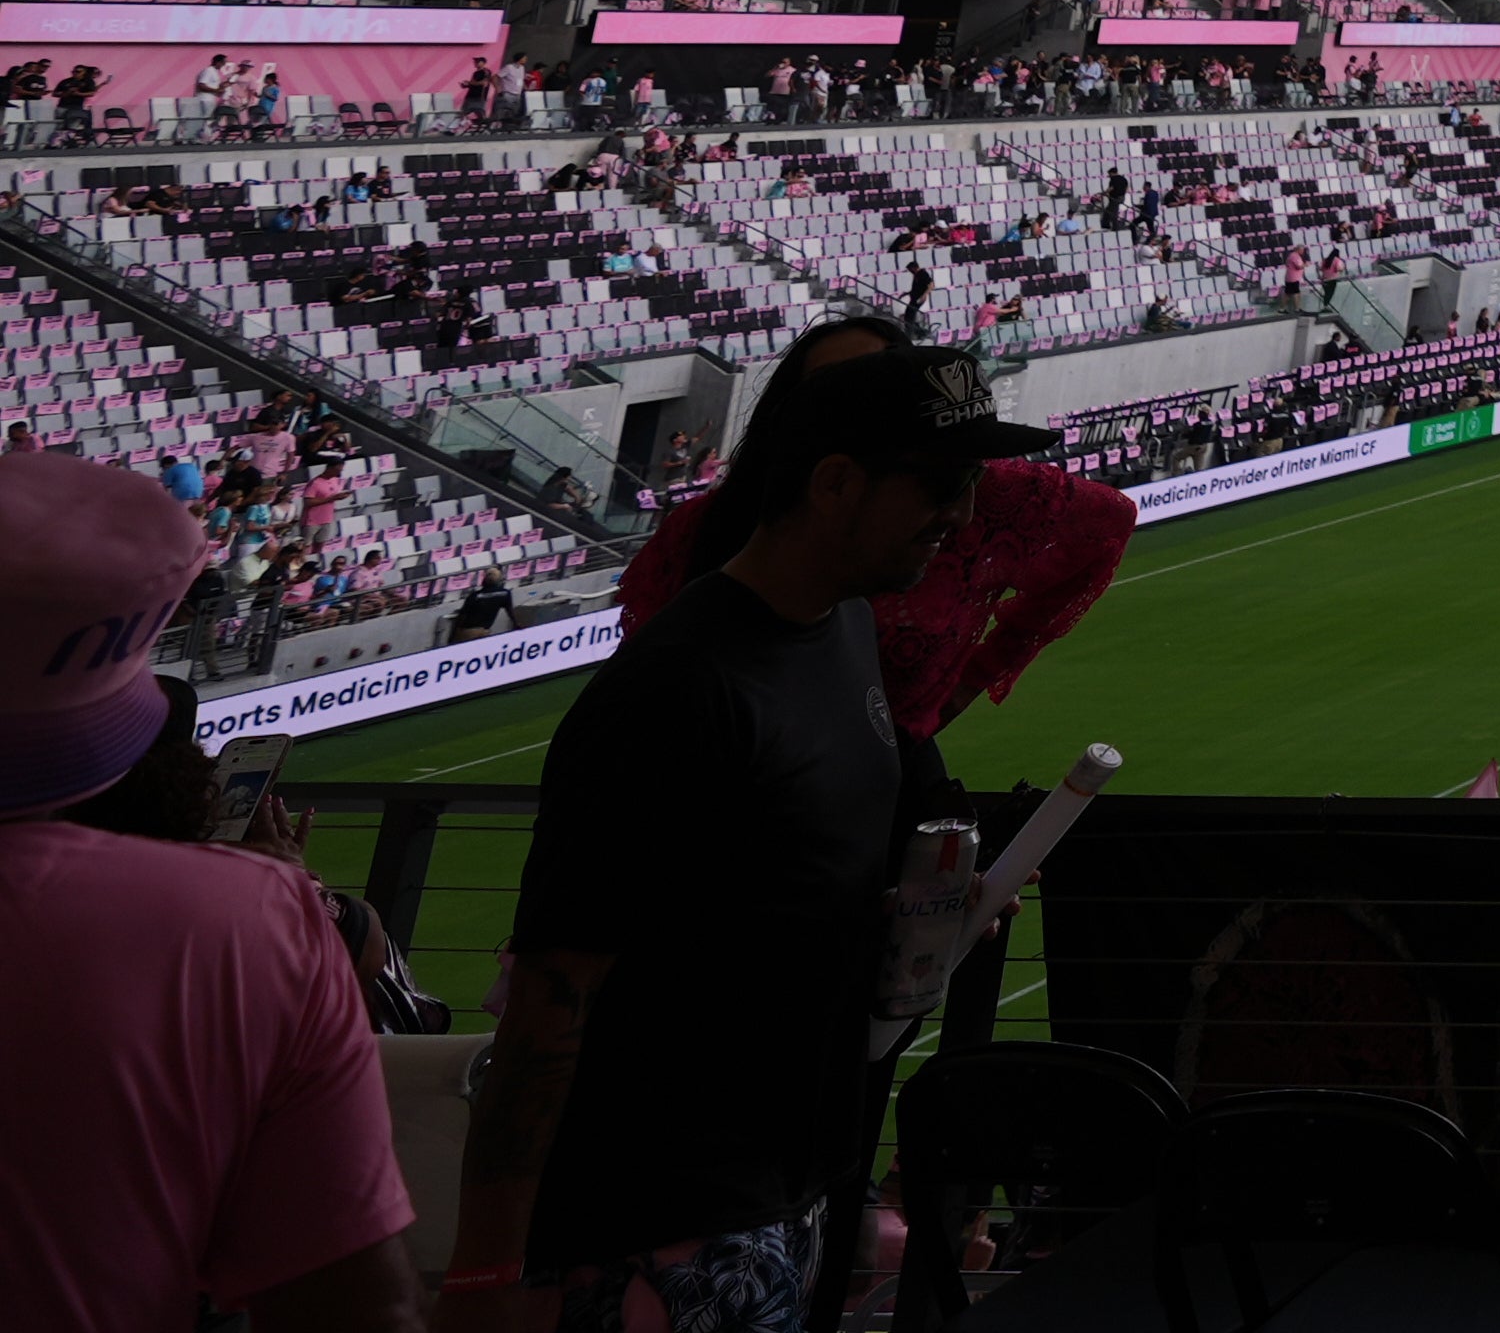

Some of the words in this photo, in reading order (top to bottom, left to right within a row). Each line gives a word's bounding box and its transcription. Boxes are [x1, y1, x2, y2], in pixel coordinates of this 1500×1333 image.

[41, 17, 81, 34] HOY
[83, 18, 146, 34] JUEGA
[1140, 480, 1207, 511] Medicine
[1211, 468, 1269, 495] Provider
[1271, 459, 1284, 479] of
[1287, 452, 1316, 475] Inter
[1319, 444, 1359, 468] Miami
[1361, 439, 1378, 457] CF
[195, 702, 282, 743] ports
[289, 668, 429, 720] Medicine
[437, 635, 553, 683] Provider
[559, 627, 585, 653] of
[589, 618, 622, 644] Int
